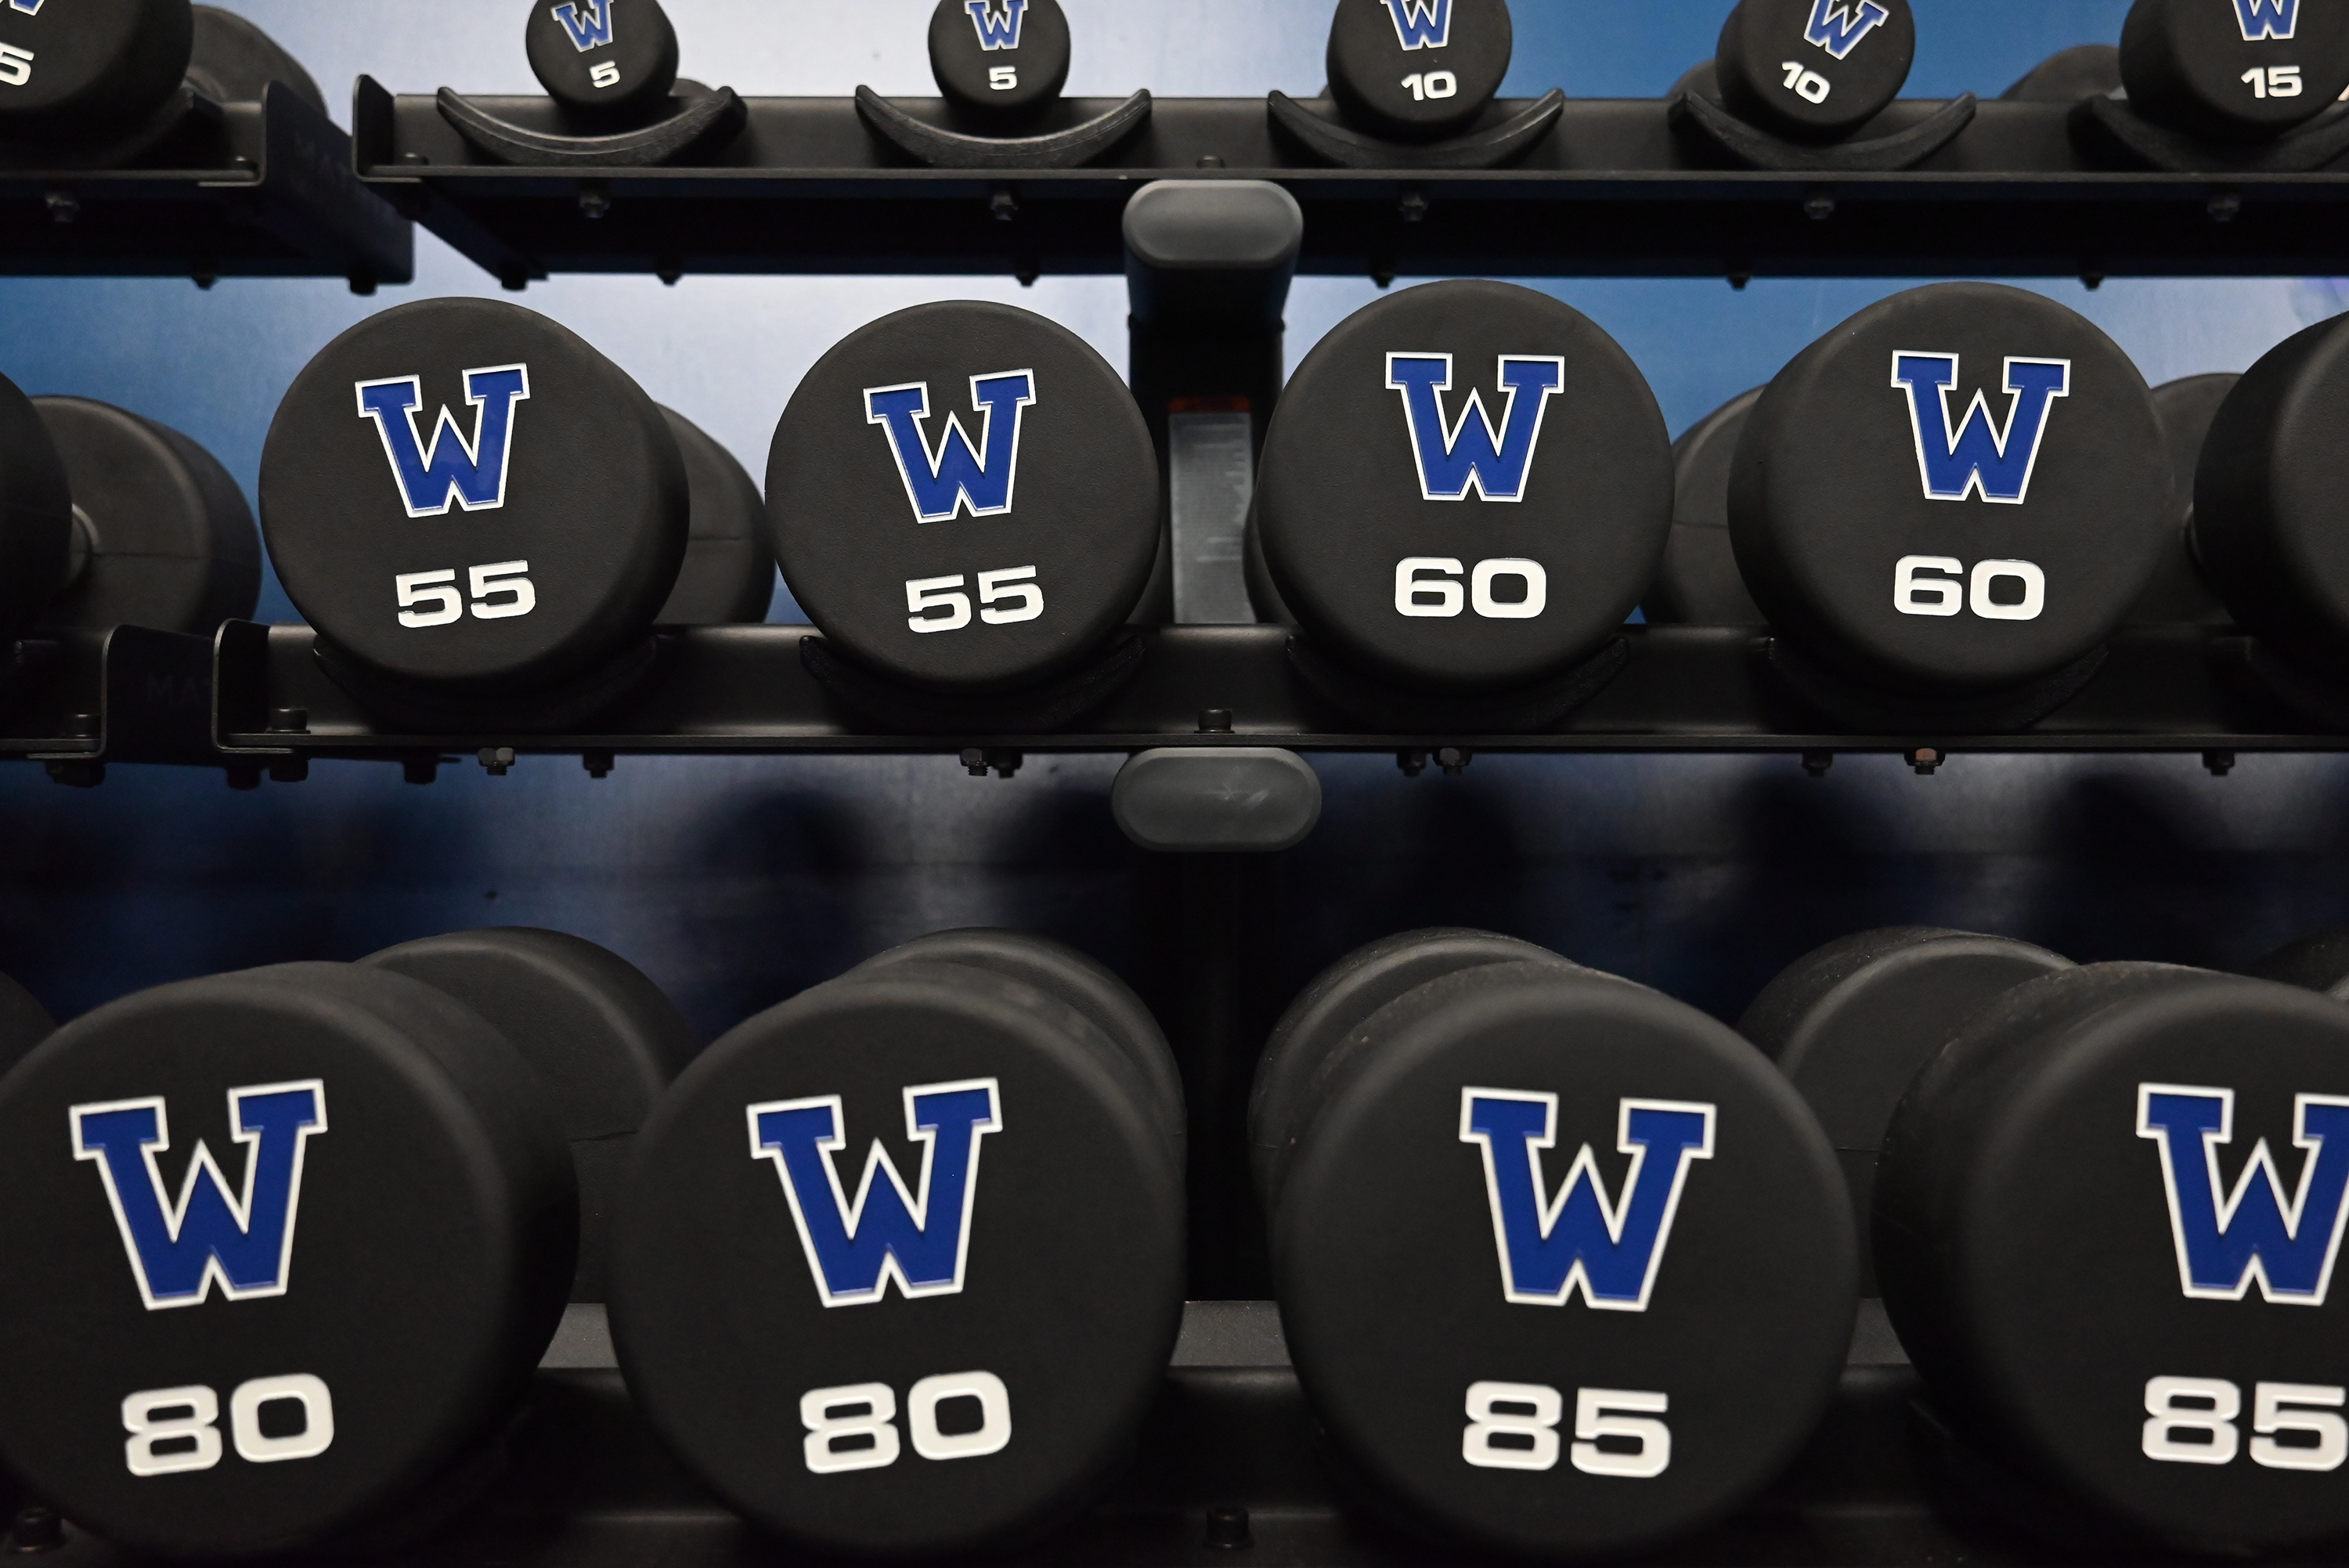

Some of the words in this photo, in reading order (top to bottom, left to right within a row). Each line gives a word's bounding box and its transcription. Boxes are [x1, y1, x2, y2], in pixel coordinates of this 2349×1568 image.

[550, 0, 615, 52] W
[964, 0, 1029, 52] W
[1380, 0, 1453, 51] W
[1803, 0, 1889, 60] W
[589, 60, 620, 88] 5
[988, 66, 1018, 90] 5
[1401, 70, 1457, 101] 10
[1781, 61, 1831, 104] 10
[2240, 66, 2303, 99] 15
[354, 362, 531, 518] W
[863, 368, 1037, 524] W
[1384, 351, 1565, 503] W
[1890, 349, 2071, 505] W
[395, 559, 536, 629] 55
[905, 564, 1045, 633] 55
[1395, 557, 1546, 618] 60
[1893, 554, 2045, 621] 60
[69, 1079, 328, 1310] W
[746, 1077, 1003, 1308] W
[1459, 1087, 1716, 1312] W
[2135, 1083, 2349, 1306] W
[121, 1374, 334, 1476] 80
[799, 1371, 1012, 1474] 80
[1462, 1381, 1671, 1478] 85
[2142, 1376, 2348, 1471] 85
